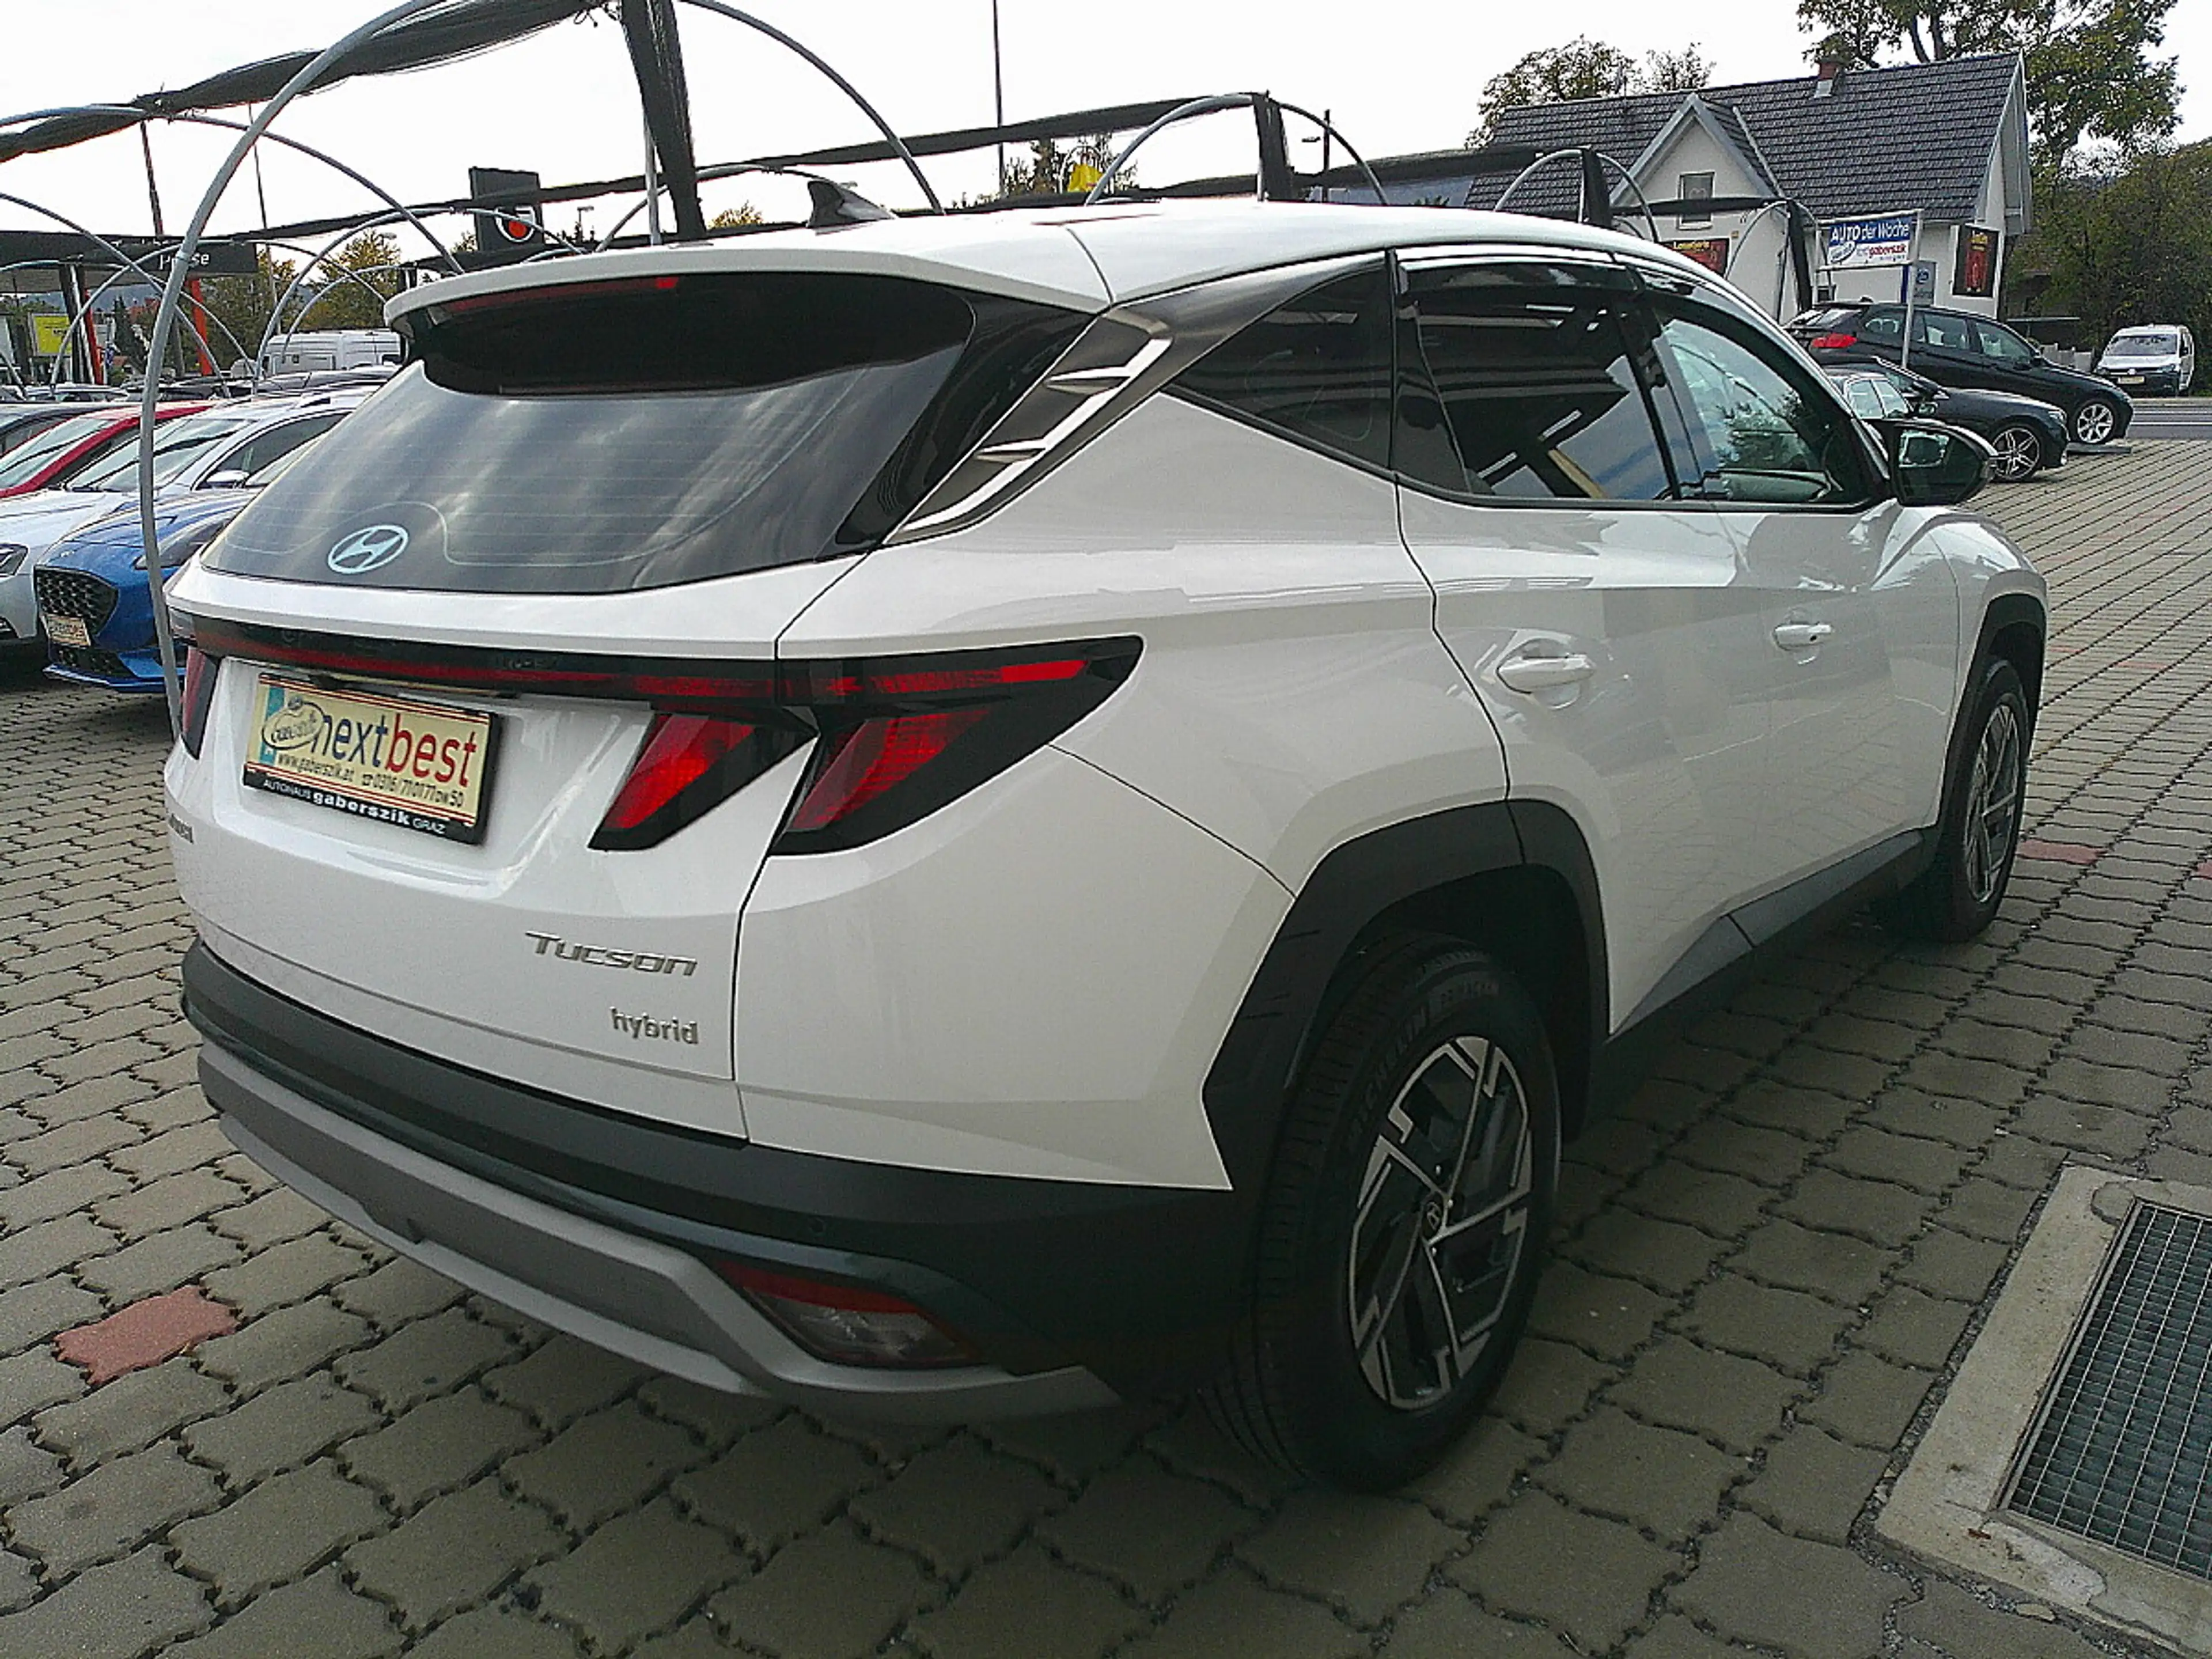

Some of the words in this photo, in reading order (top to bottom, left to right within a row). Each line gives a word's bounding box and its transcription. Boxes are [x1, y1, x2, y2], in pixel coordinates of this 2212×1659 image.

[1831, 224, 1861, 242] AUTO
[1862, 225, 1877, 240] der
[1878, 219, 1909, 239] Woche
[310, 713, 477, 787] nextbest
[263, 779, 311, 799] AUTOHAUS
[313, 792, 410, 825] gaberszik
[412, 817, 446, 835] GRAZ
[609, 1006, 699, 1044] hybrid
